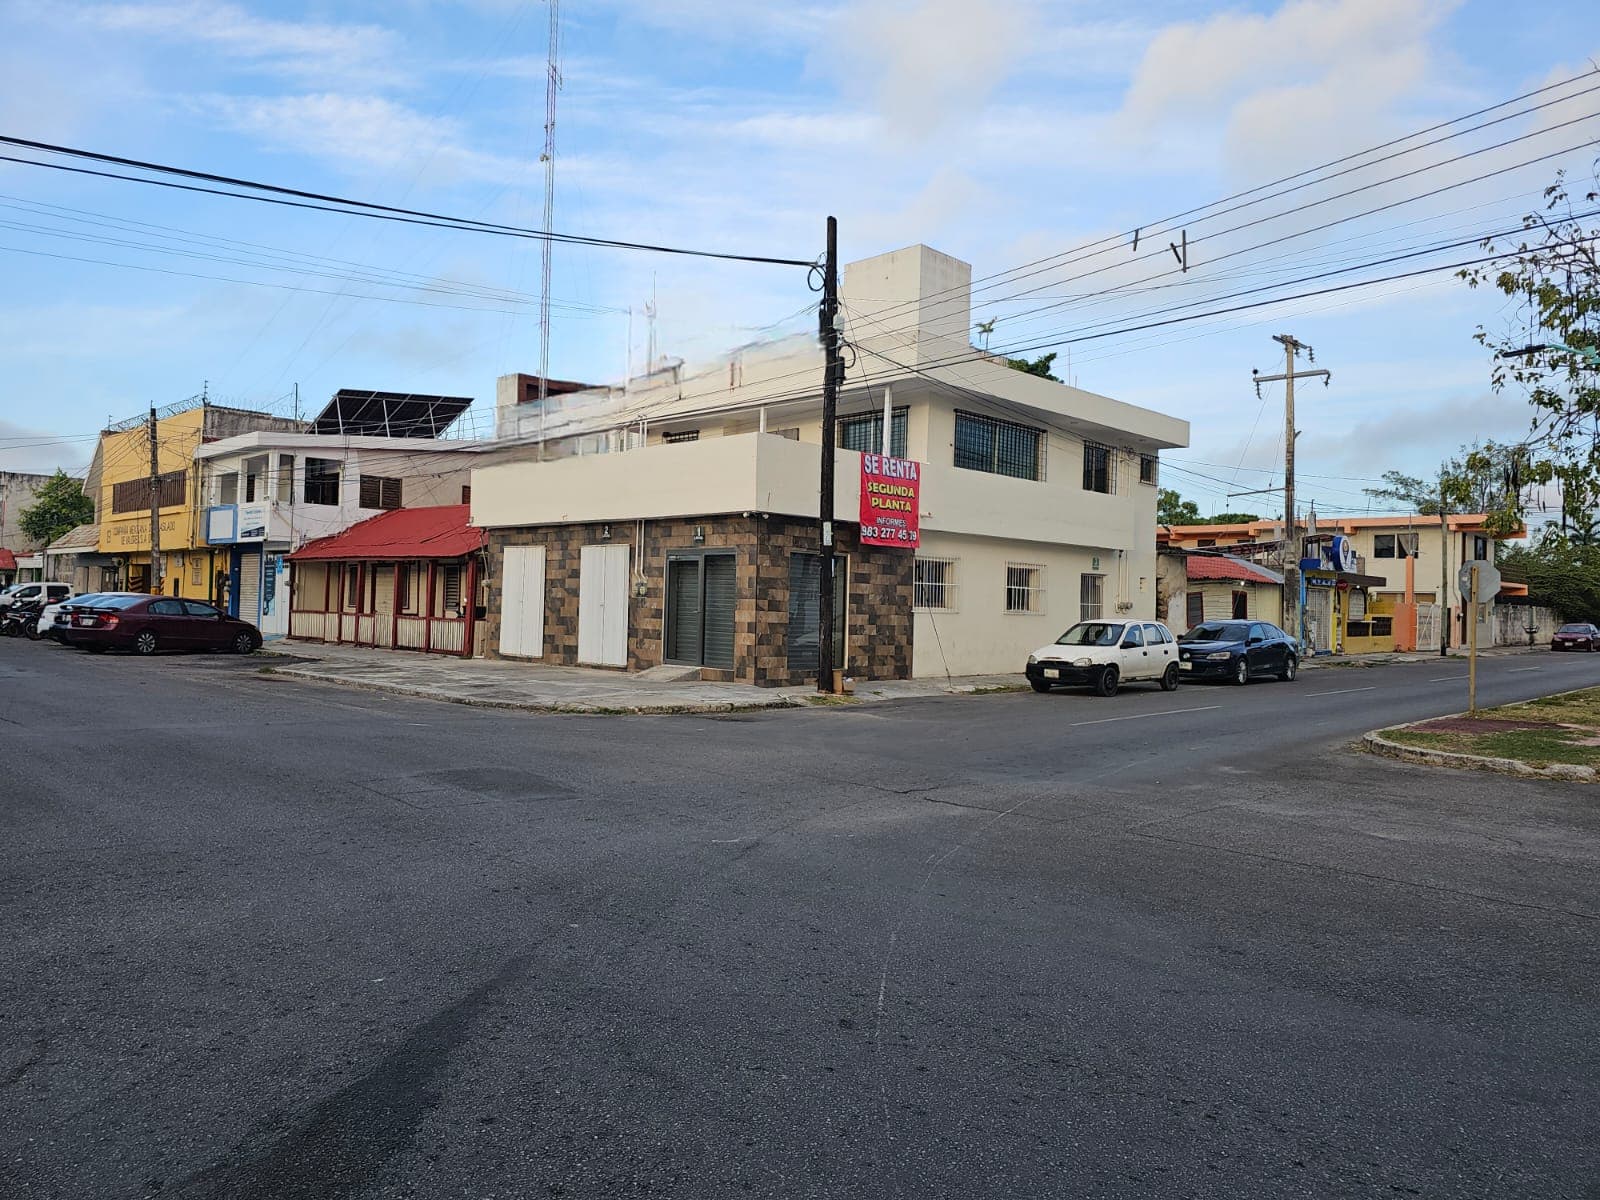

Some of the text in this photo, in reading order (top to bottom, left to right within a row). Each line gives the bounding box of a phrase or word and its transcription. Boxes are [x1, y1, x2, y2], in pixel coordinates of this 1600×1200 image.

[864, 454, 917, 480] SE RENTA
[867, 481, 915, 499] SEGUNDA
[871, 497, 912, 513] PLANTA
[861, 525, 879, 537] 983
[880, 527, 896, 539] 277
[897, 529, 907, 540] 45
